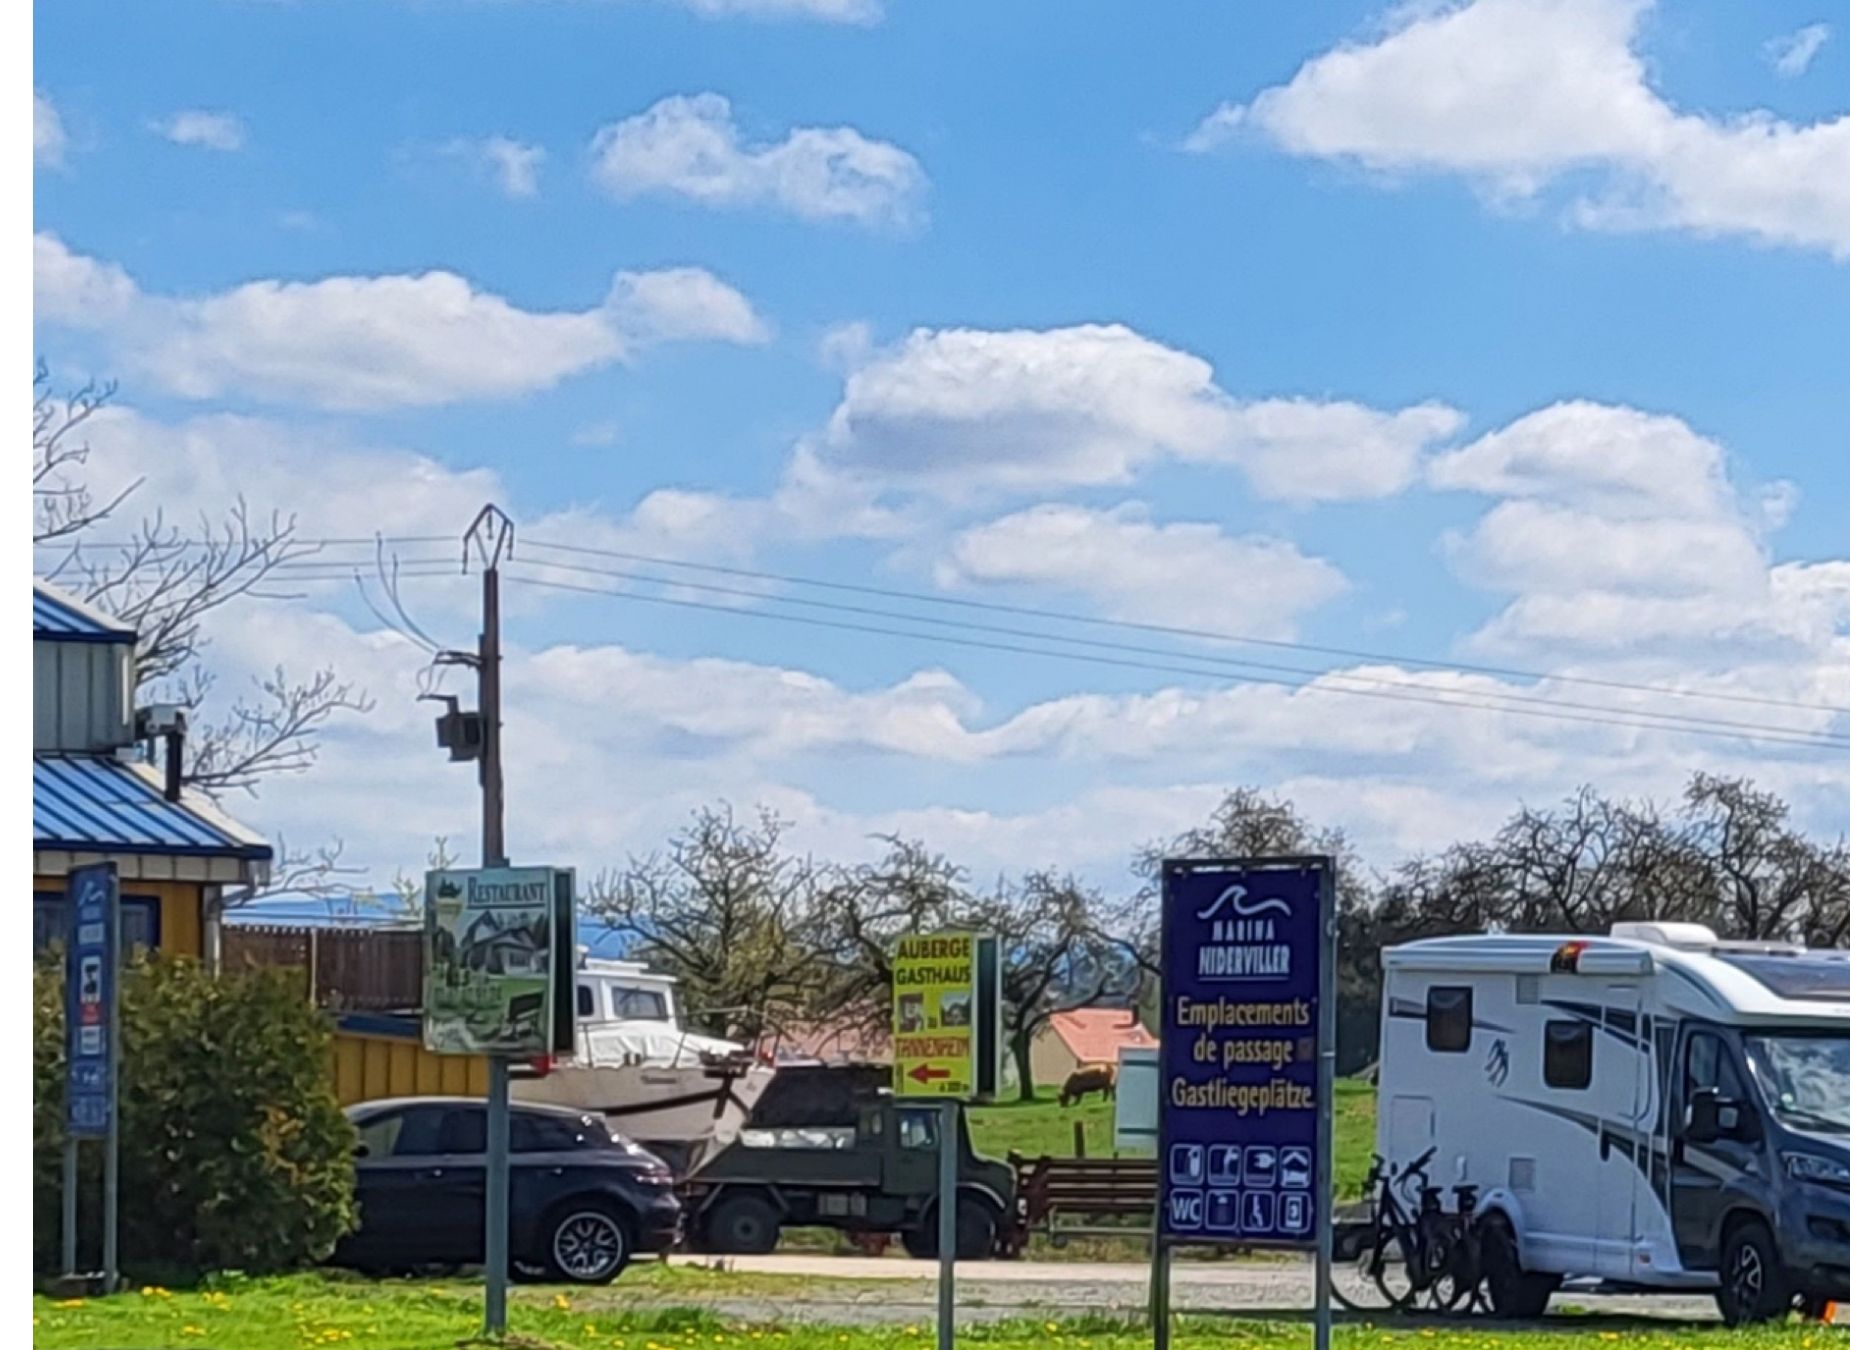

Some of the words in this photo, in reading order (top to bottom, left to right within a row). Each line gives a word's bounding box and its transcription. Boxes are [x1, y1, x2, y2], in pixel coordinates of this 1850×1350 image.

[1211, 919, 1275, 941] MARINA
[897, 938, 970, 959] AUBERGE
[1198, 944, 1290, 975] NIDERVILLER
[896, 966, 971, 985] GASTHAUS
[1176, 995, 1310, 1033] Emplacements
[1193, 1032, 1217, 1062] de
[1222, 1039, 1294, 1071] passage
[1171, 1196, 1201, 1222] WC
